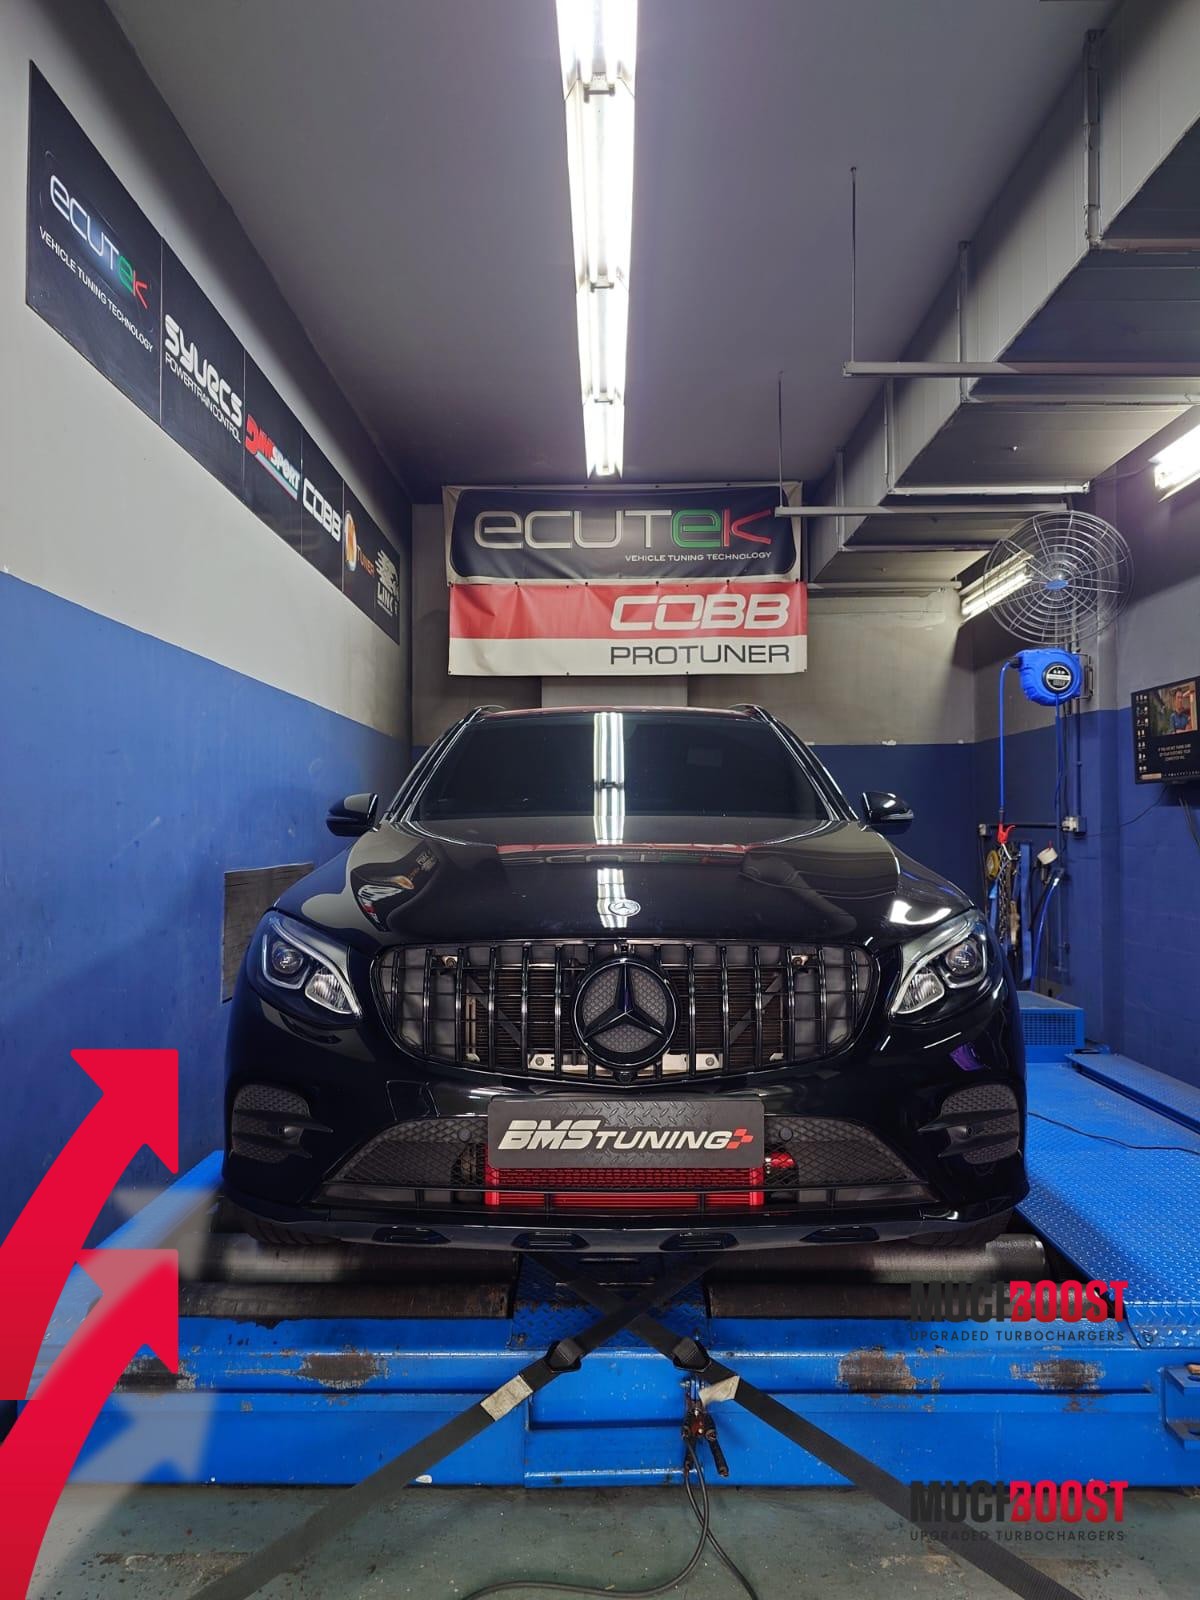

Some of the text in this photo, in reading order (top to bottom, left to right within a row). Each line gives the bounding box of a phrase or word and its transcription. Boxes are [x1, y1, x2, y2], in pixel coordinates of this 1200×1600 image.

[39, 225, 153, 353] VEHICLE TUNING TECHNOLOGY
[302, 477, 342, 542] COBB
[624, 551, 772, 562] VEHICLE TUNING TECHNOLOGY
[610, 593, 789, 630] COBB
[610, 643, 790, 665] PROTUNER
